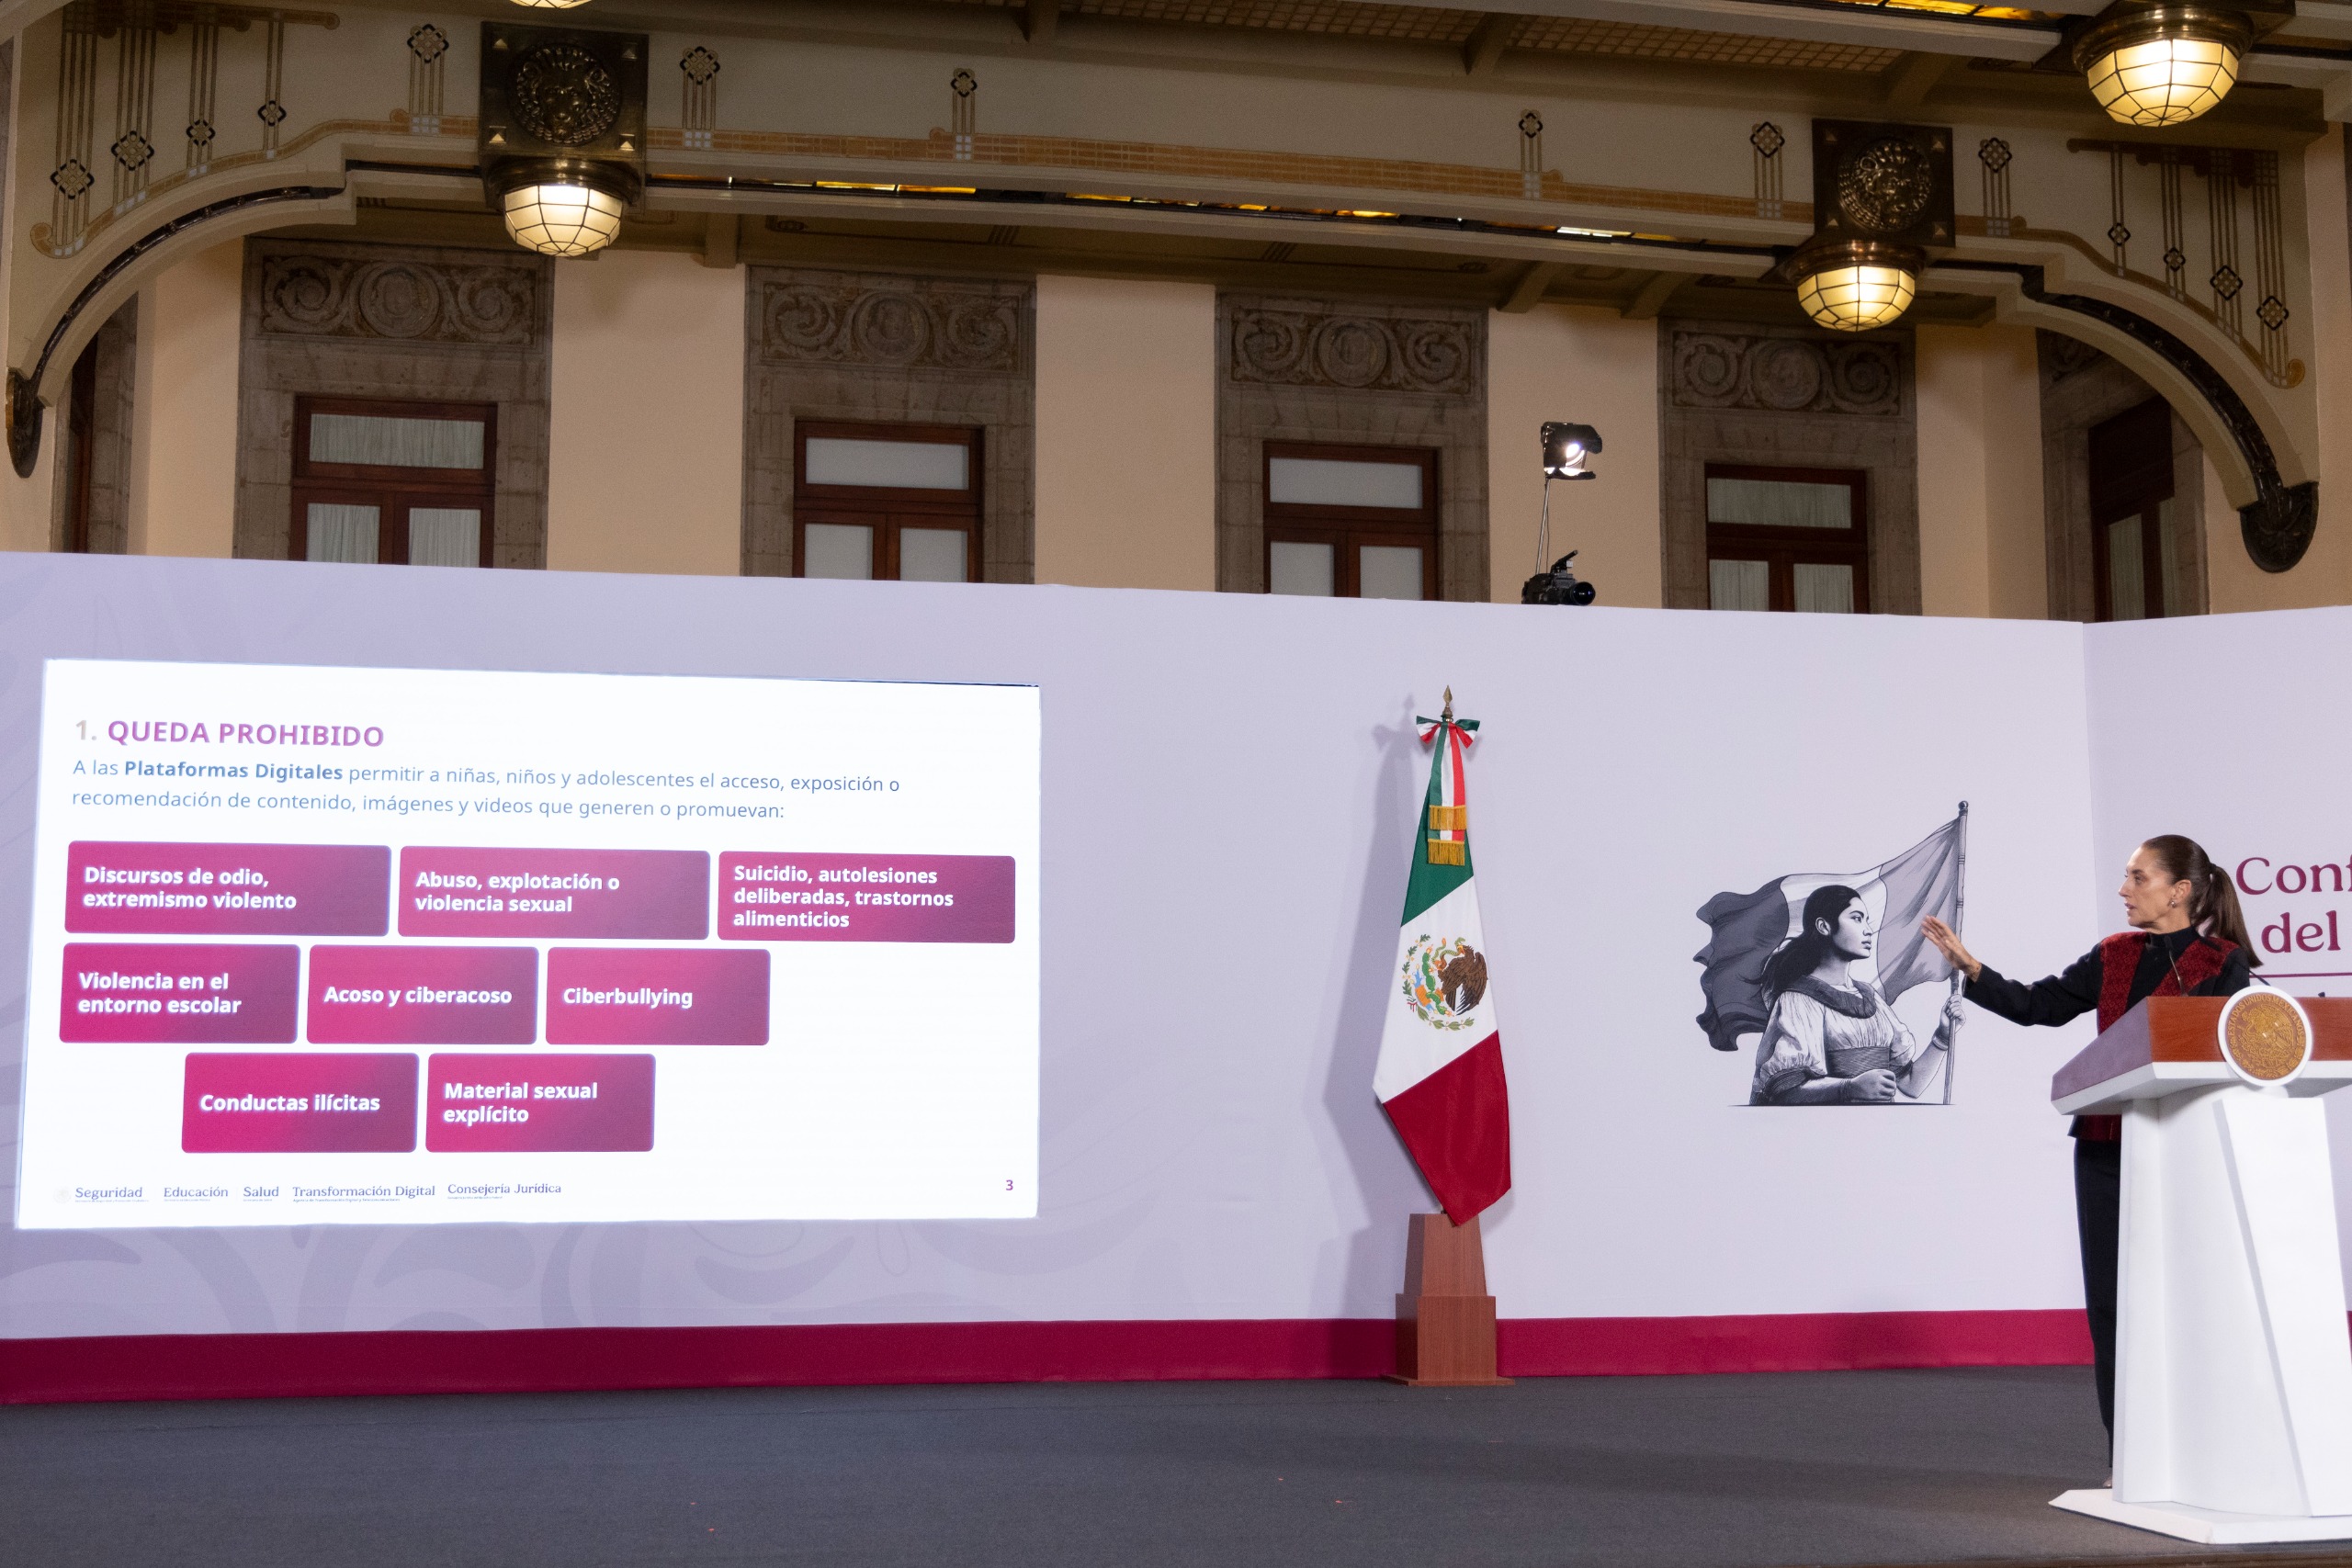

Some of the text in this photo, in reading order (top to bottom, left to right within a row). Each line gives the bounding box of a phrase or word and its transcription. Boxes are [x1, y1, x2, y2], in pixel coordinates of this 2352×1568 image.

[76, 720, 383, 747] 1. QUEDA PROHIBIDO
[74, 760, 899, 794] A las Plataformas Digitales permitir a niñas, niños y adolescentes el acceso, exposición o
[74, 791, 784, 820] recomendación de contenido, imágenes y videos que generen o promuevan:
[85, 867, 268, 887] Discursos de odio,
[735, 865, 937, 884] Suicidio, autolesiones
[416, 872, 619, 895] Abuso, explotación o
[84, 891, 296, 908] extremismo violento
[415, 895, 571, 911] violencia sexual
[734, 887, 953, 907] deliberadas, trastornos
[734, 910, 849, 927] alimenticios
[2261, 910, 2341, 953] del
[79, 972, 228, 989] Violencia en el
[78, 997, 242, 1013] entorno escolar
[324, 987, 512, 1007] Acoso y ciberacoso
[564, 987, 692, 1009] Ciberbullying
[2227, 993, 2305, 1037] ESTADOS UNIDOS MEXICANOS
[446, 1082, 597, 1099] Material sexual
[200, 1094, 379, 1111] Conductas ilícitas
[444, 1106, 528, 1126] explícito
[164, 1187, 228, 1197] Educación
[243, 1187, 278, 1197] Salud
[293, 1186, 435, 1199] Transformación Digital
[448, 1183, 560, 1196] Consejería Jurídica
[1006, 1179, 1013, 1190] 3
[75, 1187, 142, 1200] Seguridad
